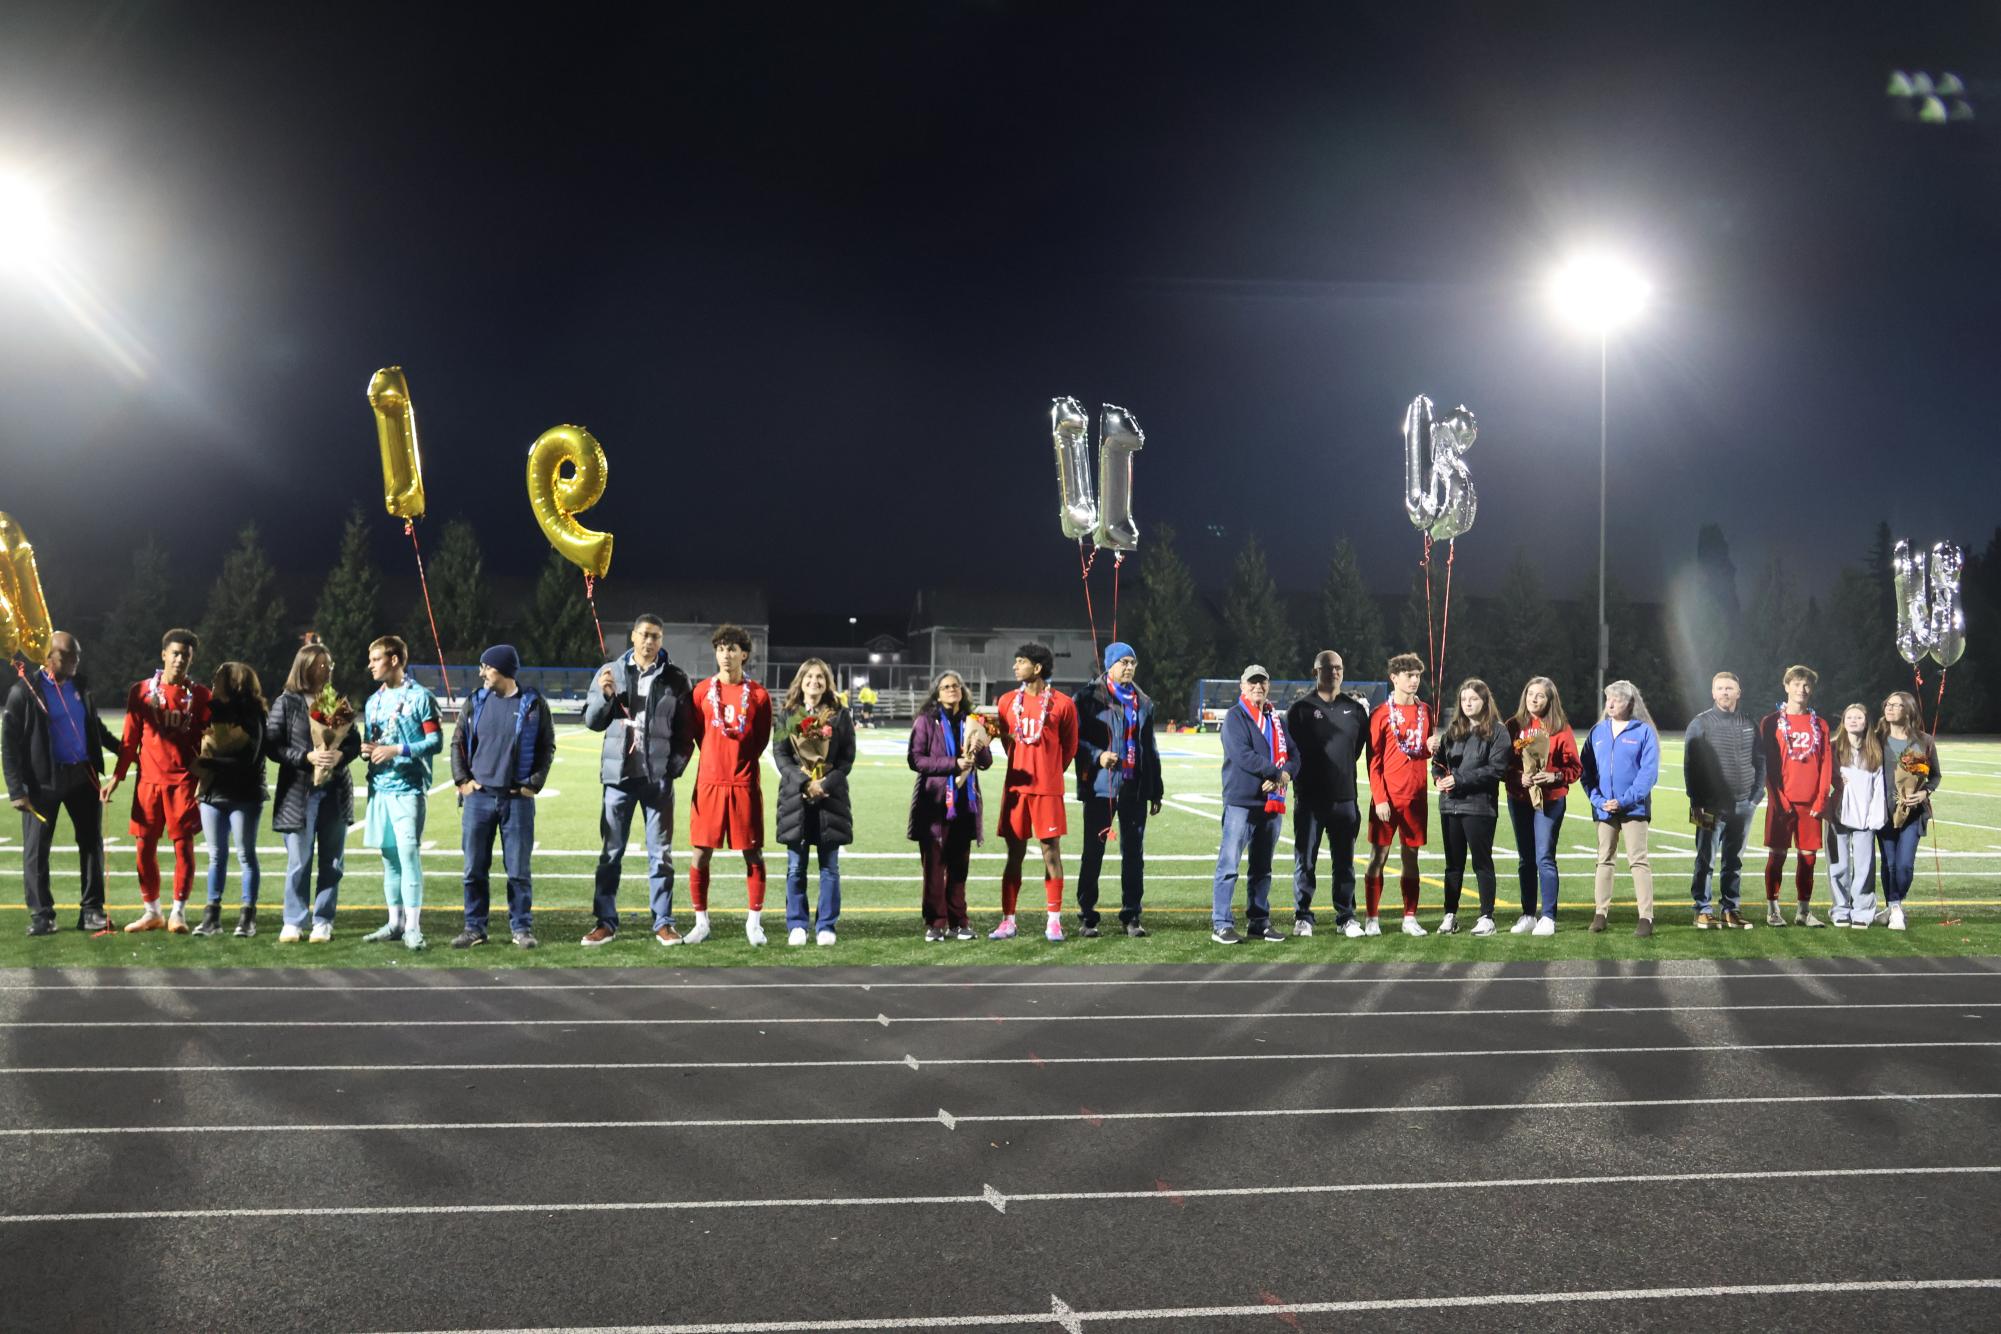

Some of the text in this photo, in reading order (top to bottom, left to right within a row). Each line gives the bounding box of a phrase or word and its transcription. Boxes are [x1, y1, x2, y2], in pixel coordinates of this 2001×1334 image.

[164, 709, 181, 727] 10
[724, 704, 735, 723] 9
[1022, 717, 1035, 737] 11
[1792, 732, 1810, 748] 22
